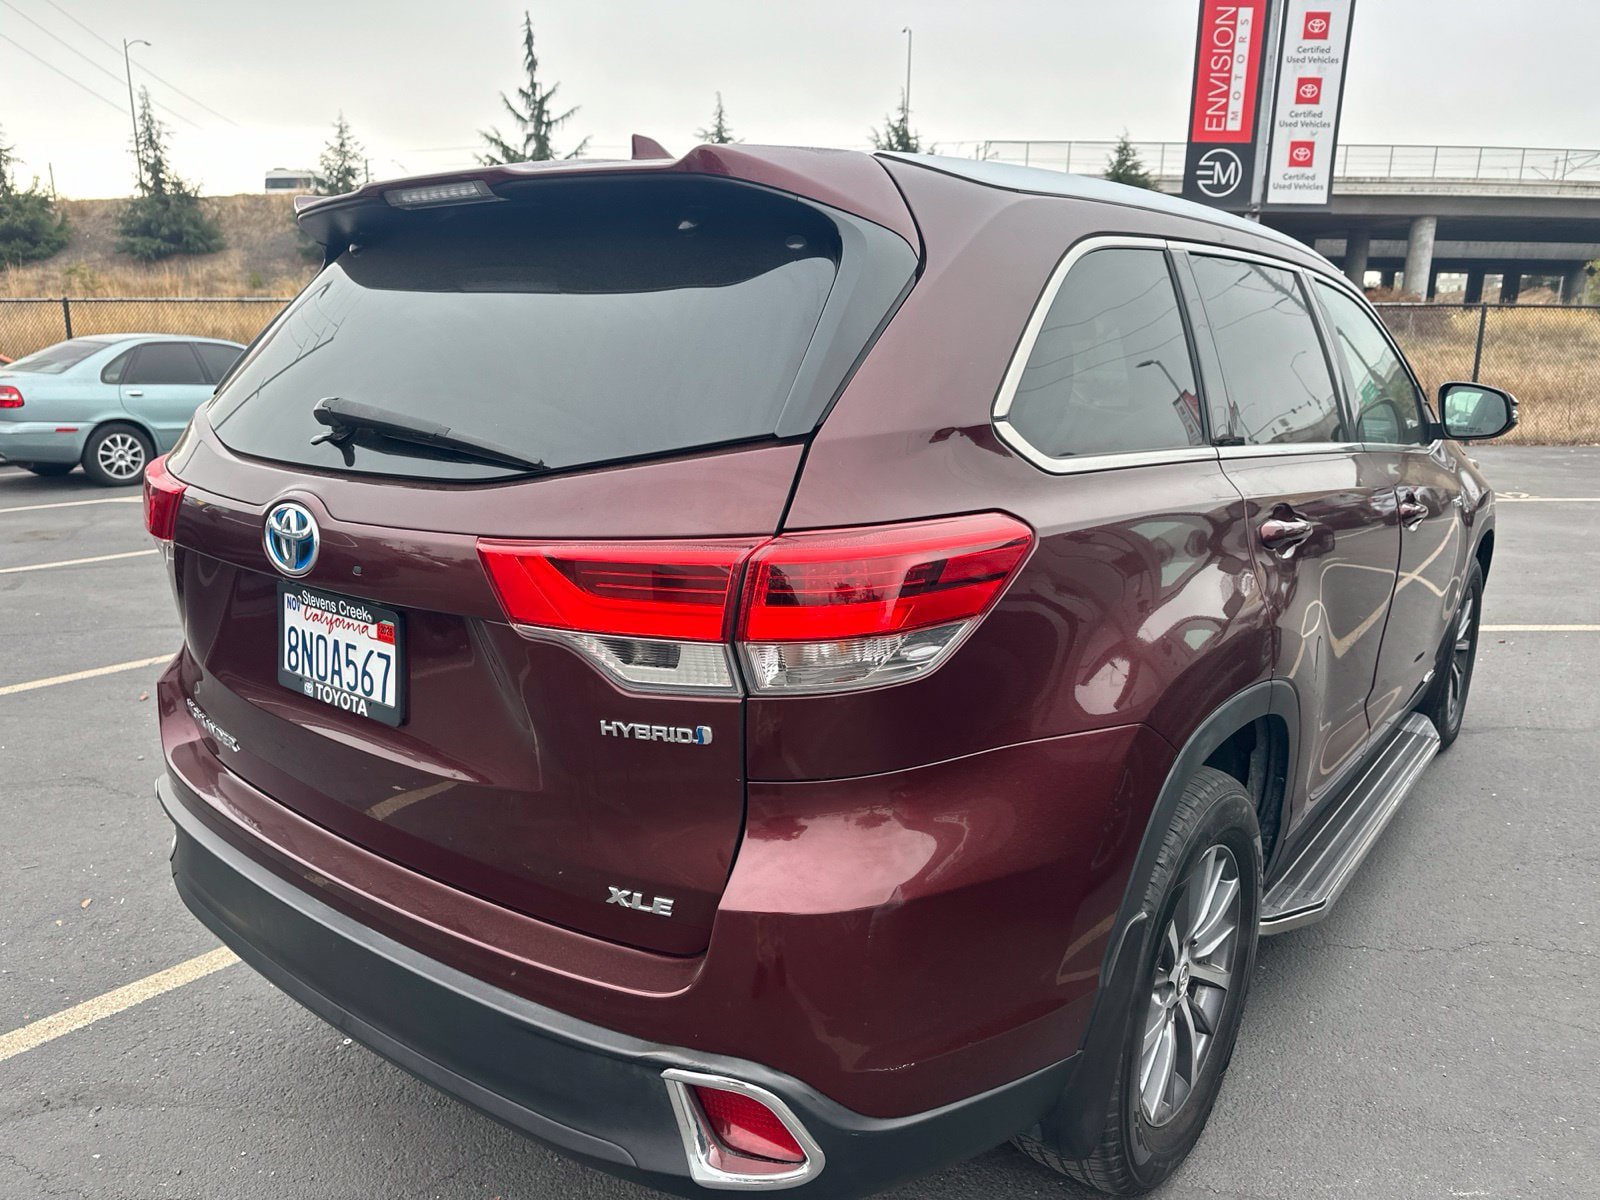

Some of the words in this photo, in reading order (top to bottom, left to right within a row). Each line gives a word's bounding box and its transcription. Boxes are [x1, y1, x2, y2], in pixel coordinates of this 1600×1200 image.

[1296, 46, 1331, 54] Certified
[1307, 56, 1339, 64] Vehicles
[1204, 6, 1237, 131] ENVISION
[1230, 18, 1250, 121] MOTORS
[1289, 110, 1323, 118] Certified
[1300, 120, 1331, 128] Vehicles
[302, 590, 337, 614] Stevens
[338, 600, 369, 622] Creek
[303, 605, 372, 637] California
[287, 625, 391, 704] 8NOA567
[315, 683, 368, 717] TOYOTA
[600, 719, 693, 744] HYBRID
[605, 886, 675, 917] XLE
